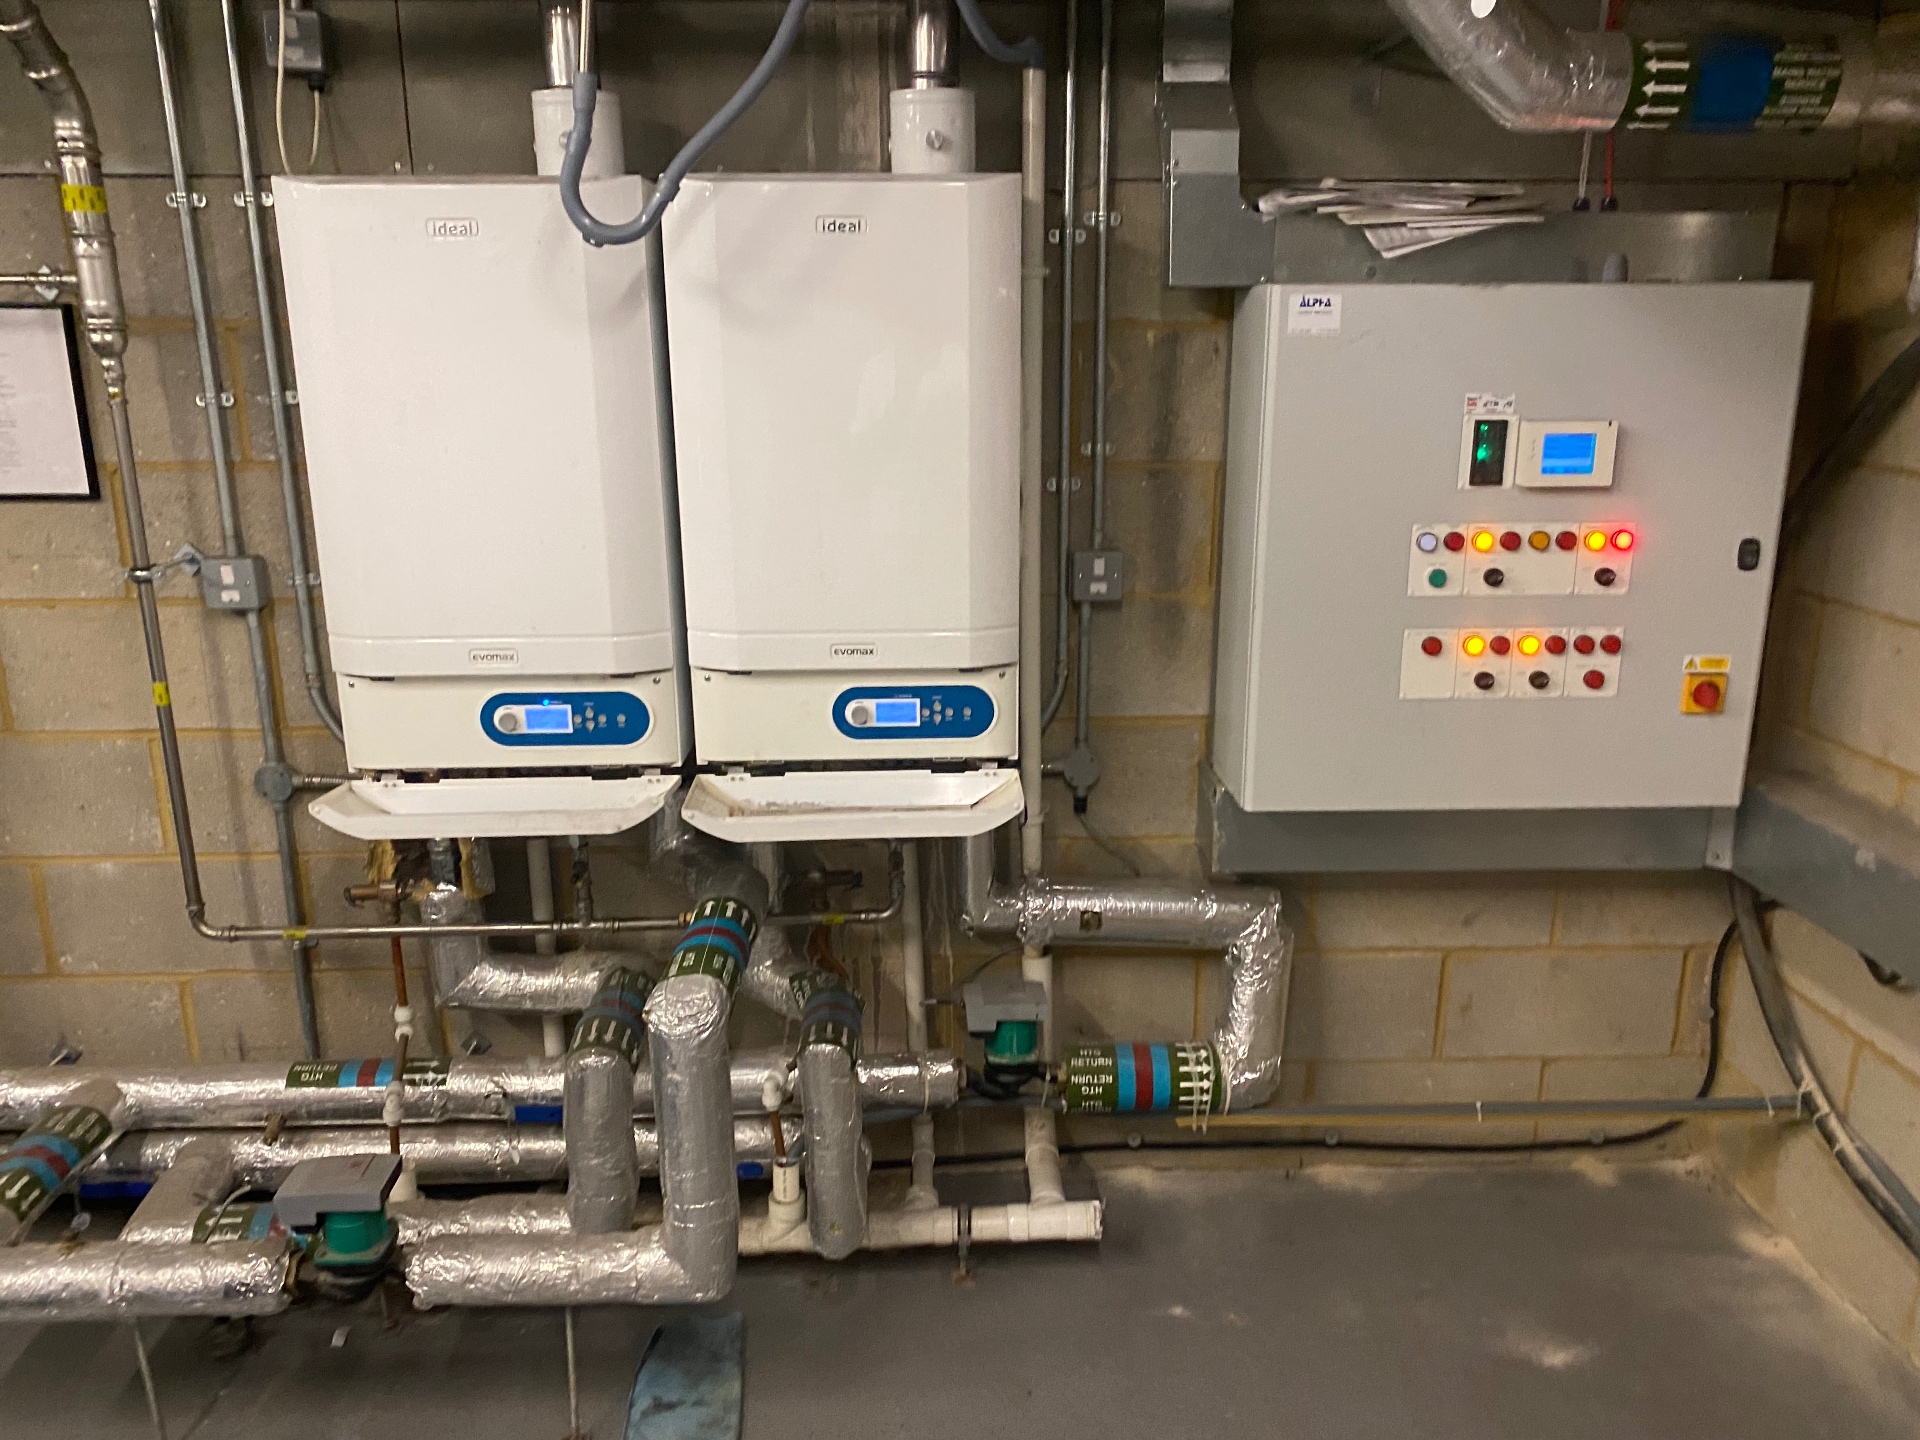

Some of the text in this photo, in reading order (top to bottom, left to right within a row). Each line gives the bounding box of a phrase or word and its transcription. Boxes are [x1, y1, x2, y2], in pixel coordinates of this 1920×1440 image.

[432, 220, 473, 236] ideal
[822, 218, 861, 233] ideal
[833, 647, 875, 656] evomax
[472, 654, 515, 662] evomax
[1070, 1058, 1112, 1067] RETURN
[301, 1073, 324, 1082] HTG
[1071, 1075, 1113, 1085] RETURN
[1082, 1086, 1103, 1095] HTG
